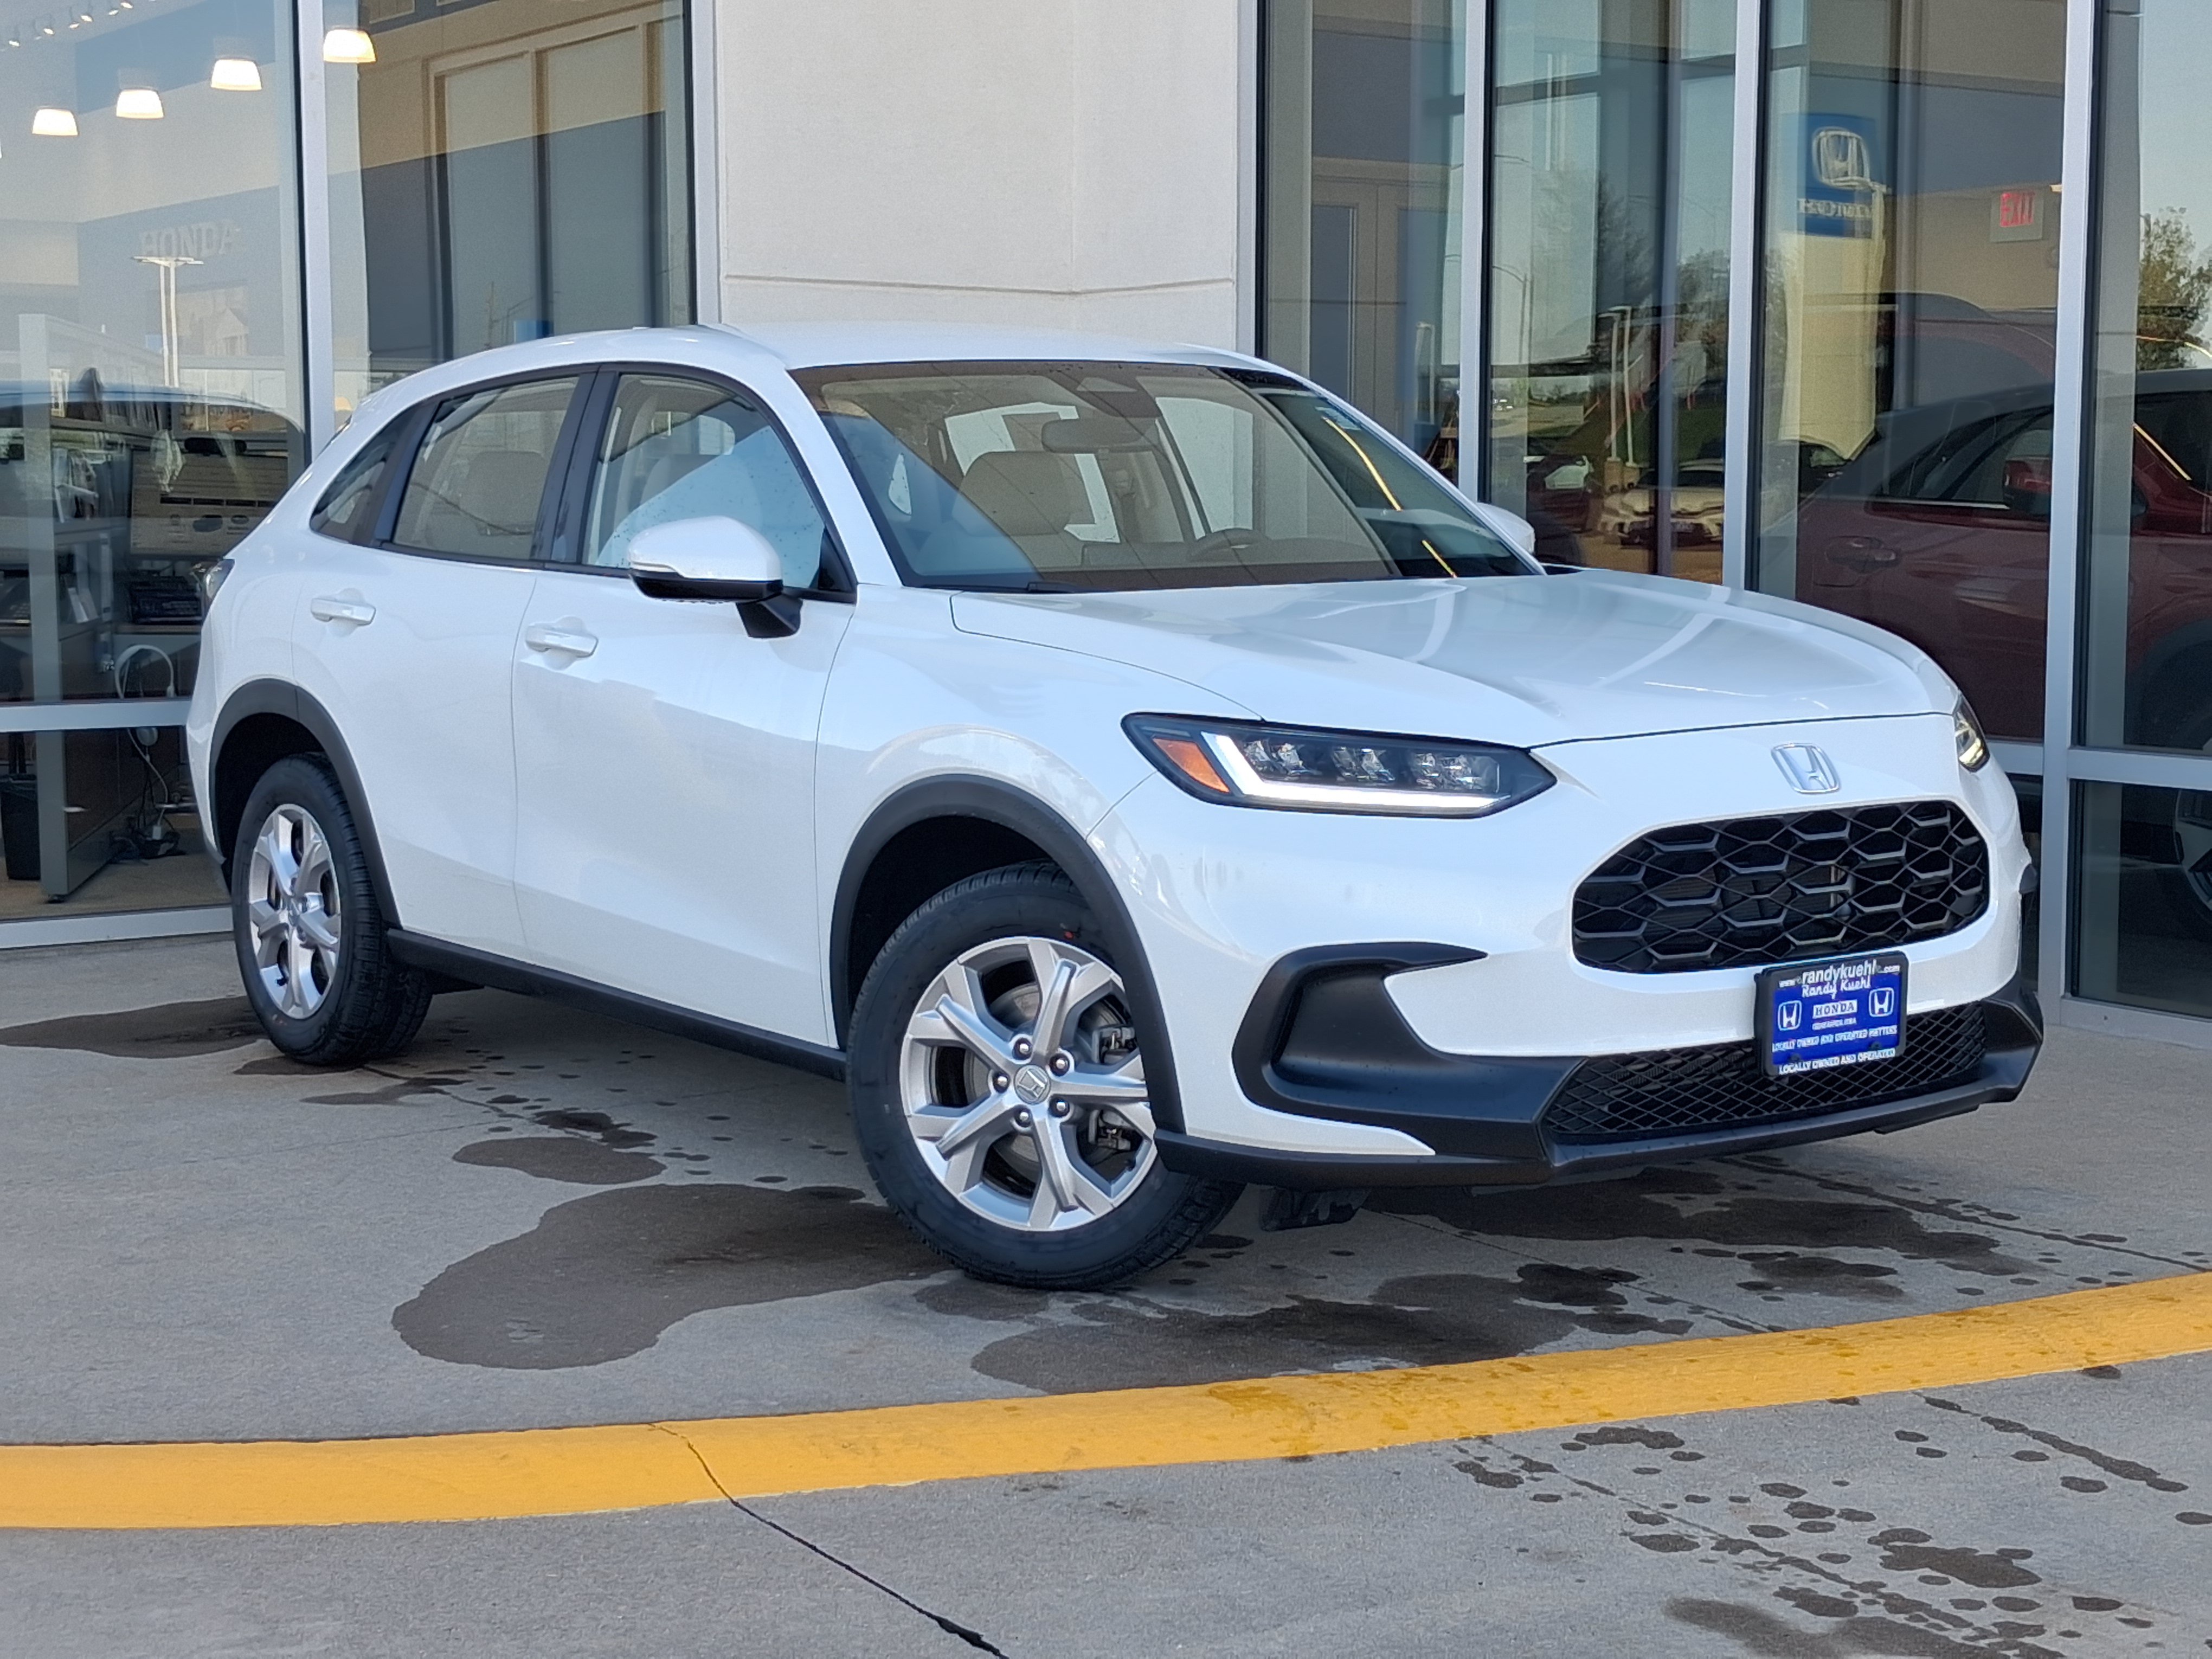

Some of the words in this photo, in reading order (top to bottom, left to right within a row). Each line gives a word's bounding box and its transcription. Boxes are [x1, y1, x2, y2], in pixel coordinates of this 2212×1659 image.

[1999, 191, 2036, 228] EXIT
[142, 218, 235, 258] HONDA
[1802, 982, 1836, 999] Randy
[1841, 976, 1870, 992] Kuehl
[1814, 1001, 1855, 1016] HONDA
[1779, 1060, 1811, 1075] LOCALLY
[1812, 1056, 1840, 1069] OWNED
[1841, 1054, 1856, 1064] AND
